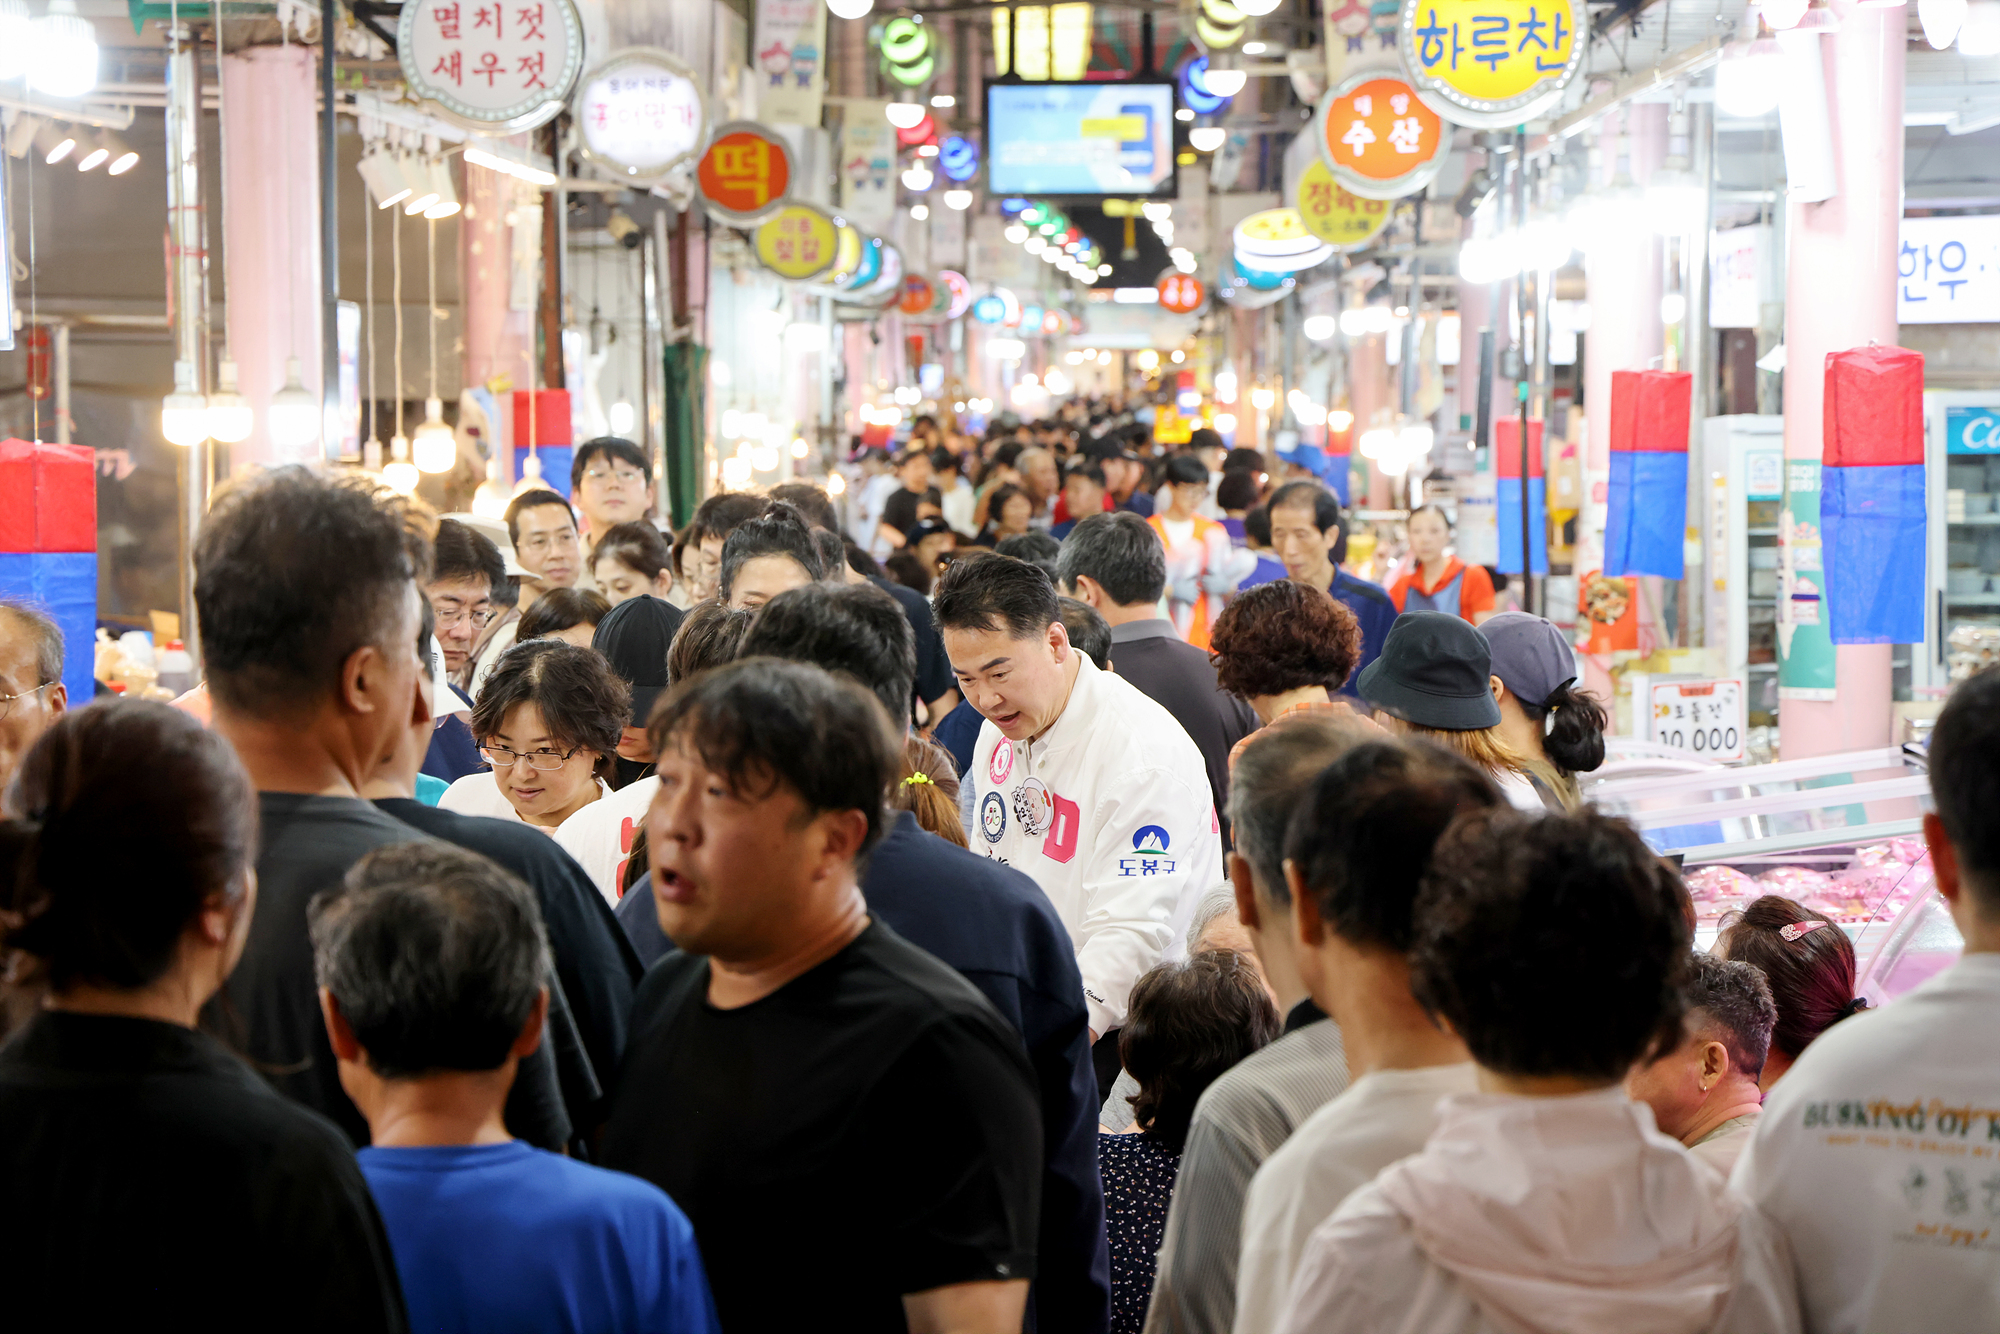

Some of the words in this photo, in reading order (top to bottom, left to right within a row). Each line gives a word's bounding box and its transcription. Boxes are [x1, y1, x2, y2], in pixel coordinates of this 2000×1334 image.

[433, 2, 545, 40] 멸치젓
[1416, 7, 1568, 71] 하루찬
[432, 51, 546, 89] 새우젓
[1341, 117, 1423, 157] 수산
[712, 139, 769, 205] 떡
[1042, 793, 1080, 864] D
[1118, 859, 1176, 876] 도봉구
